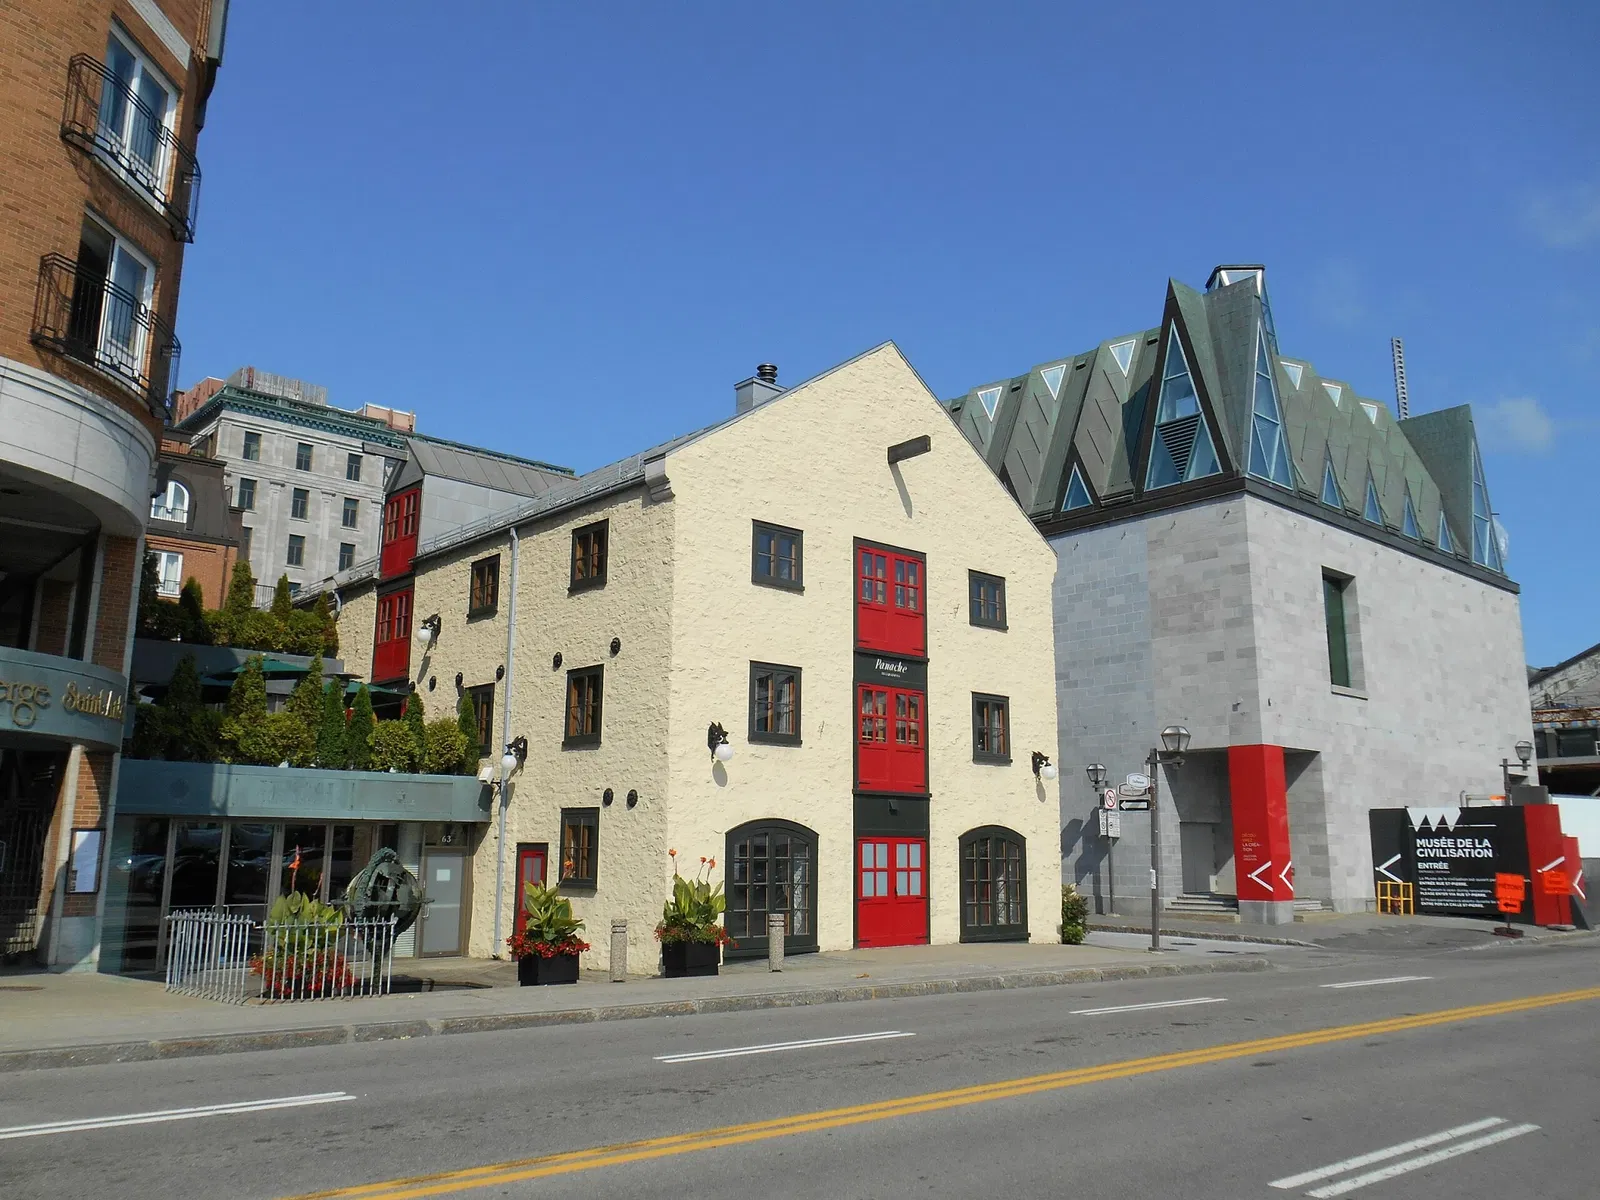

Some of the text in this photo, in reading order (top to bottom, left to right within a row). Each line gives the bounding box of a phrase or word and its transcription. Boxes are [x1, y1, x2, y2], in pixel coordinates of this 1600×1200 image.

[875, 658, 908, 674] Panache
[441, 835, 452, 843] 63
[1416, 836, 1492, 848] MUSÉE DE LA
[1416, 848, 1493, 858] CIVILISATION
[1417, 861, 1450, 869] ENTRÉE
